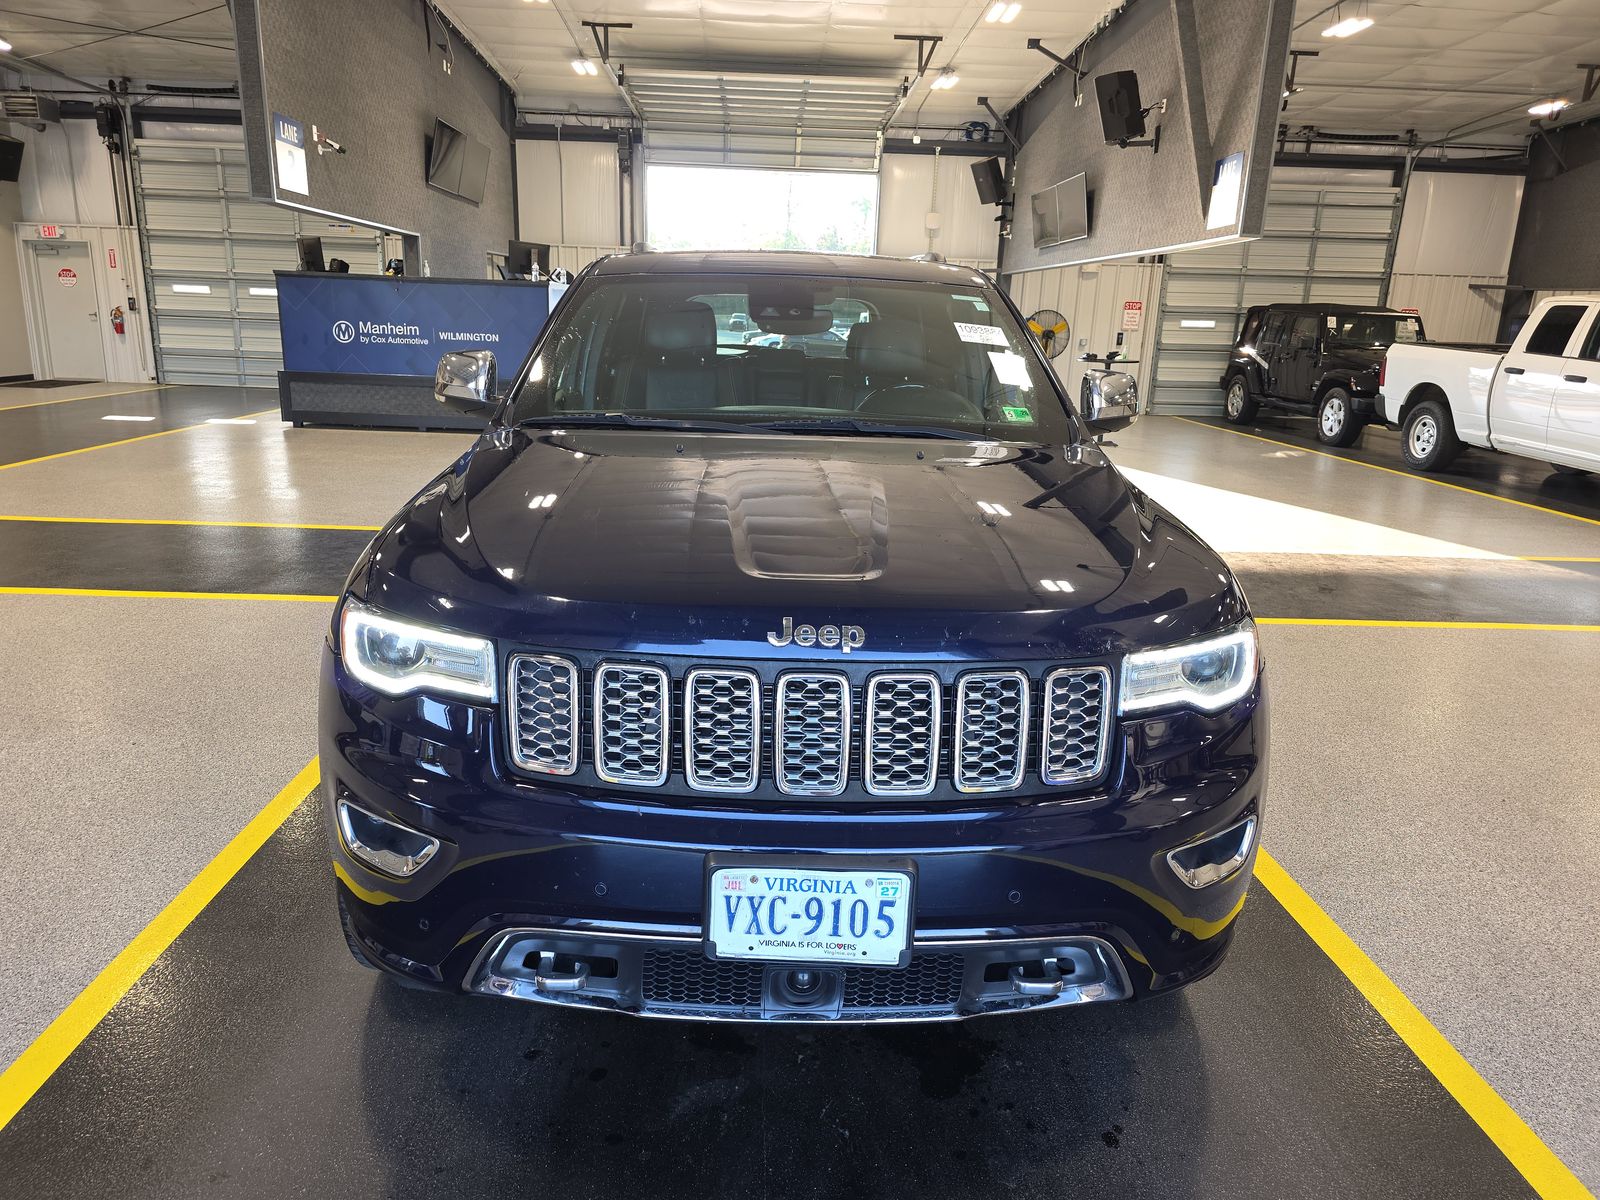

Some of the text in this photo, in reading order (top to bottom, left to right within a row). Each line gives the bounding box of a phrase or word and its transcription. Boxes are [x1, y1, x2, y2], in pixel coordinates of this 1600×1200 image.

[280, 121, 298, 143] LANE
[42, 225, 57, 237] EXIT
[1125, 302, 1141, 310] STOP
[359, 321, 420, 336] Manheim
[360, 335, 369, 344] by
[387, 336, 429, 345] Automotive
[439, 331, 499, 342] WILMINGTON
[767, 616, 866, 654] Jeep
[725, 880, 743, 890] JUL
[764, 877, 858, 894] VIRGINIA
[881, 887, 899, 897] 27
[723, 895, 897, 939] VXC-9105
[758, 939, 797, 948] VIRGINIA
[798, 941, 805, 949] IS
[806, 941, 824, 949] FOR
